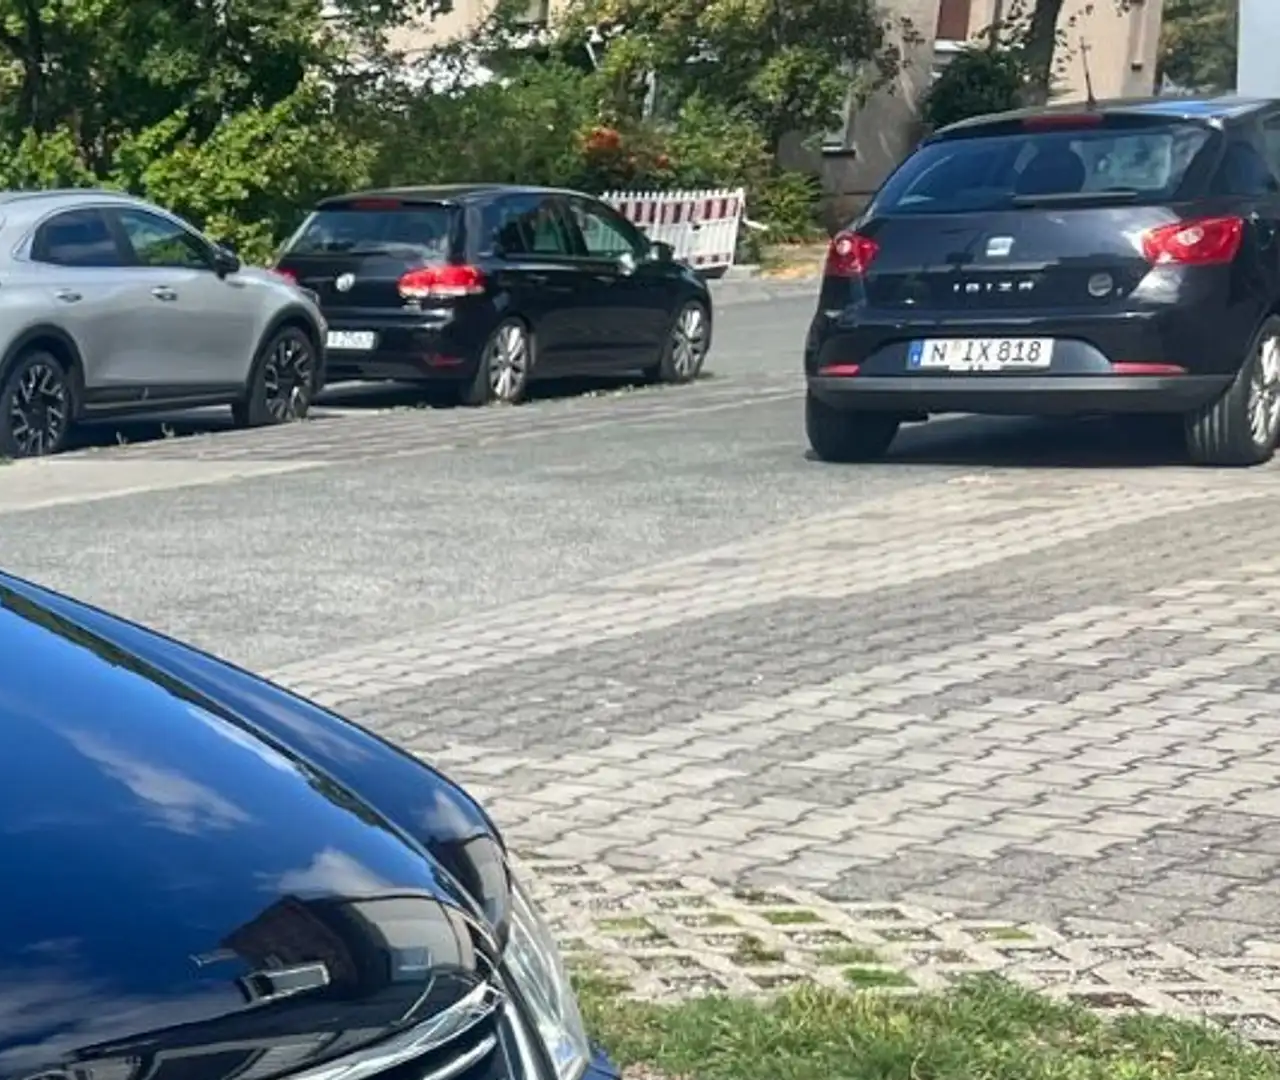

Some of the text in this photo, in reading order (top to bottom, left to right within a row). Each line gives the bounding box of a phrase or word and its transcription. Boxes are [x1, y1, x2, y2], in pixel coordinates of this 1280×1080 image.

[953, 280, 1035, 294] IBIZA
[930, 341, 1042, 362] N IX 818
